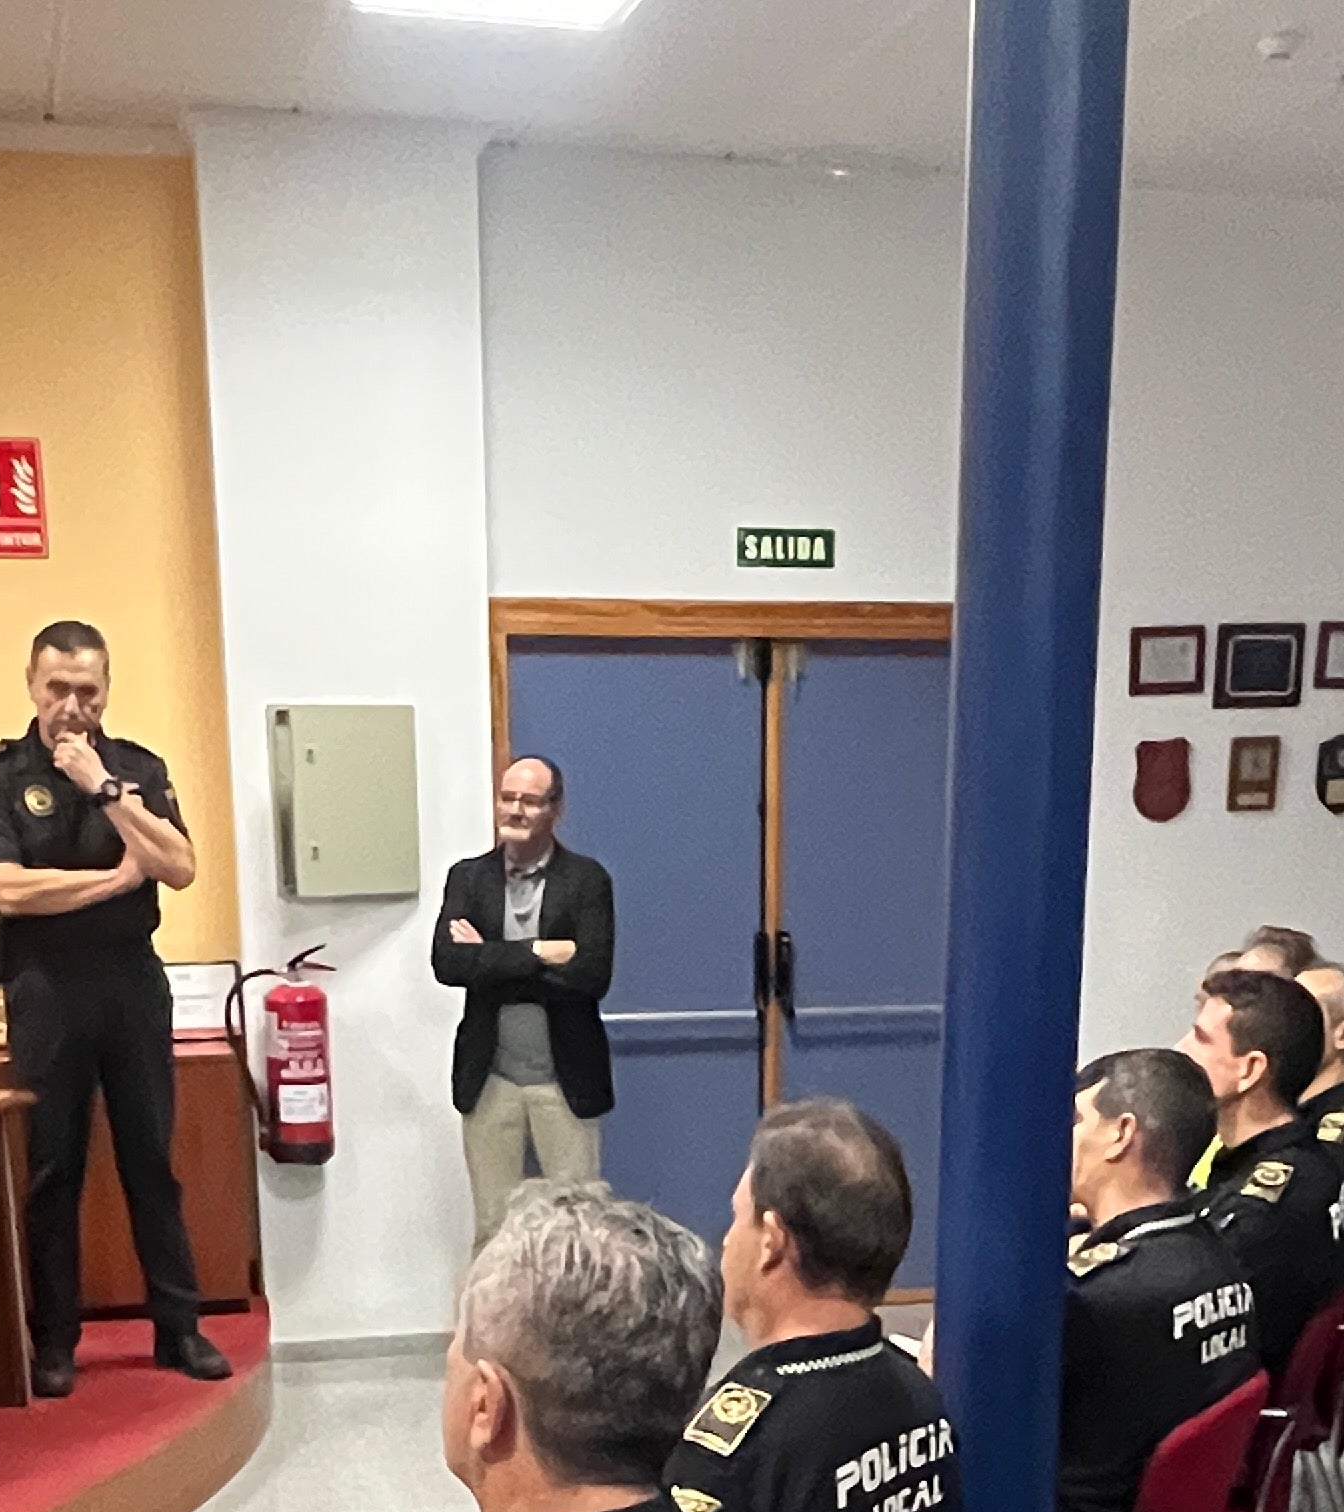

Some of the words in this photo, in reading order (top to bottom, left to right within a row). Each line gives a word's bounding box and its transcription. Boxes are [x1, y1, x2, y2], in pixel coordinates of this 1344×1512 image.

[744, 534, 826, 561] SALIDA
[1173, 1282, 1255, 1340] POLICIA
[835, 1418, 954, 1510] POLICIA
